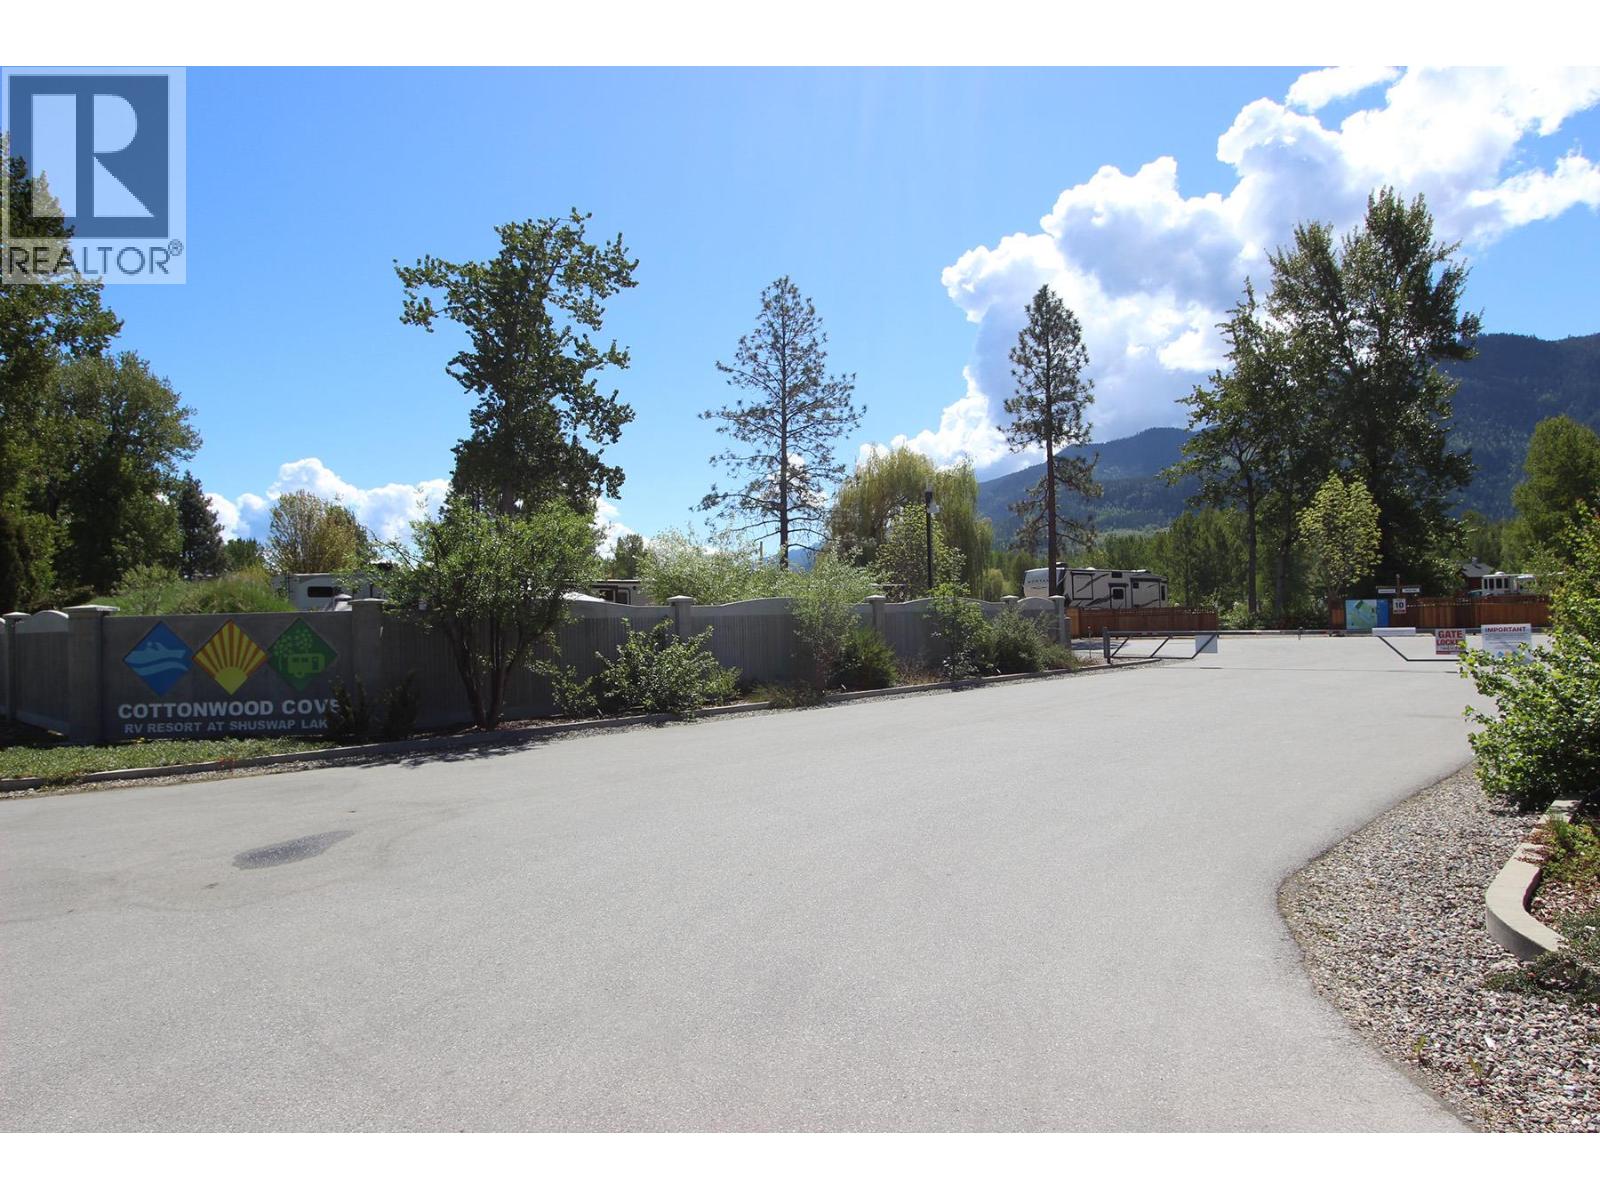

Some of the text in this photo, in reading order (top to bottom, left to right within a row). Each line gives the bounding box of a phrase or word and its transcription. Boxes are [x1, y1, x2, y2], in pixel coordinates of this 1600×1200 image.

[1438, 630, 1463, 639] GATE
[118, 700, 274, 719] COTTONWOOD
[124, 719, 329, 734] RV RESORT AT SHUSWAP LAK
